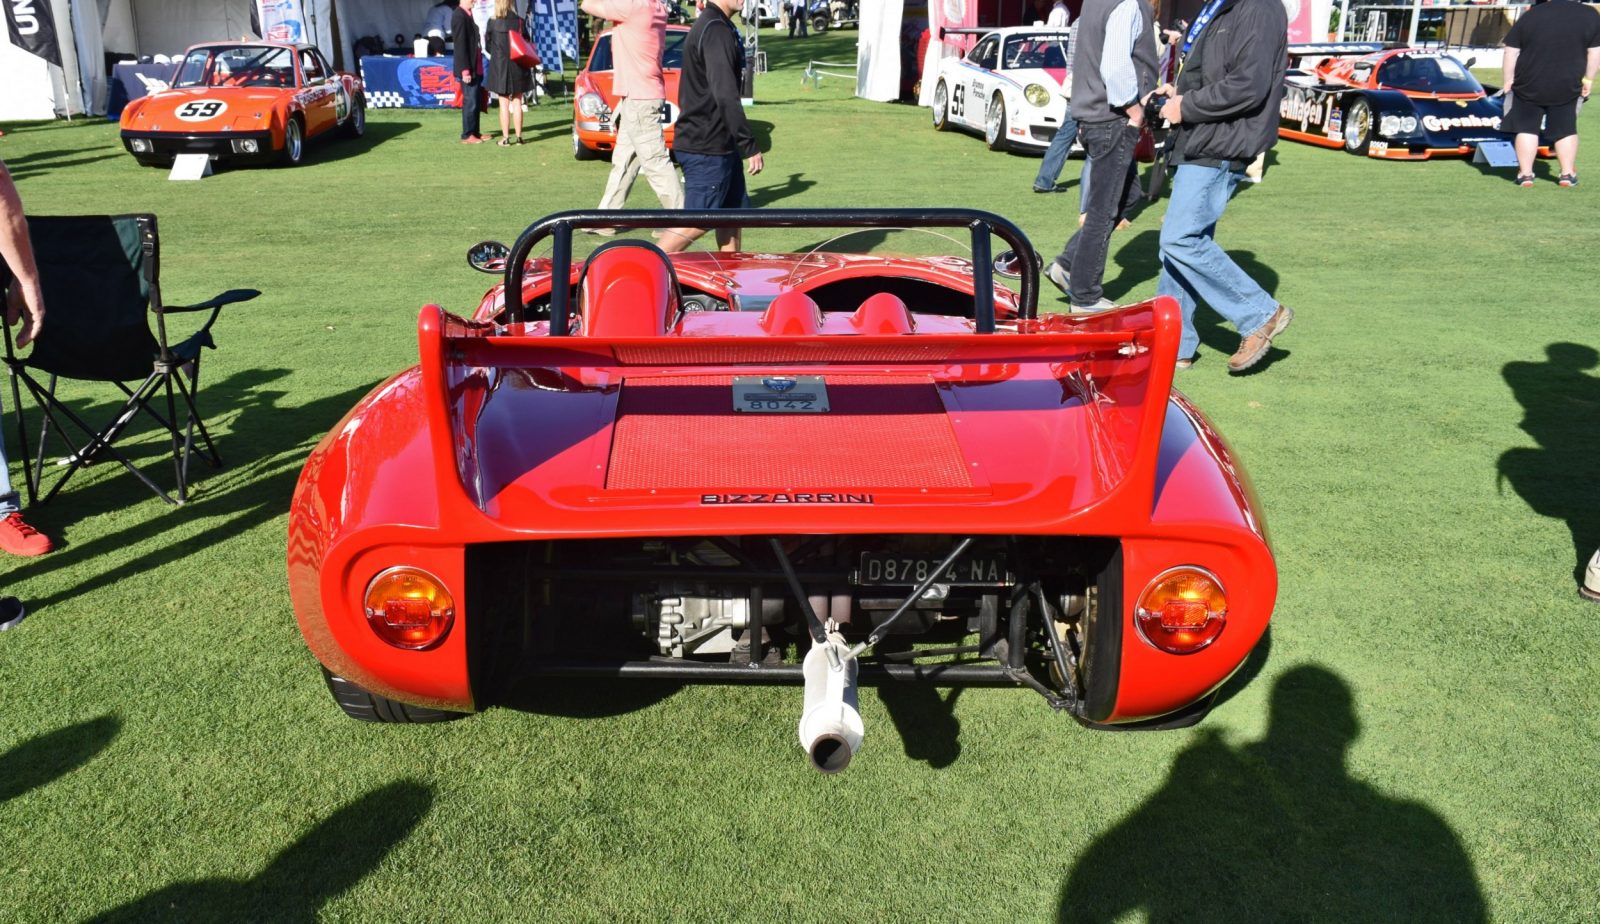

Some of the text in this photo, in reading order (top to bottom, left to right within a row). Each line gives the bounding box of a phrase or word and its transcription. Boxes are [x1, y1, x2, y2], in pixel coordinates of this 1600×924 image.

[952, 84, 965, 117] 59
[180, 102, 223, 117] 59
[750, 401, 815, 410] 8042
[700, 494, 874, 505] BIZZARRINI
[971, 559, 999, 582] NA
